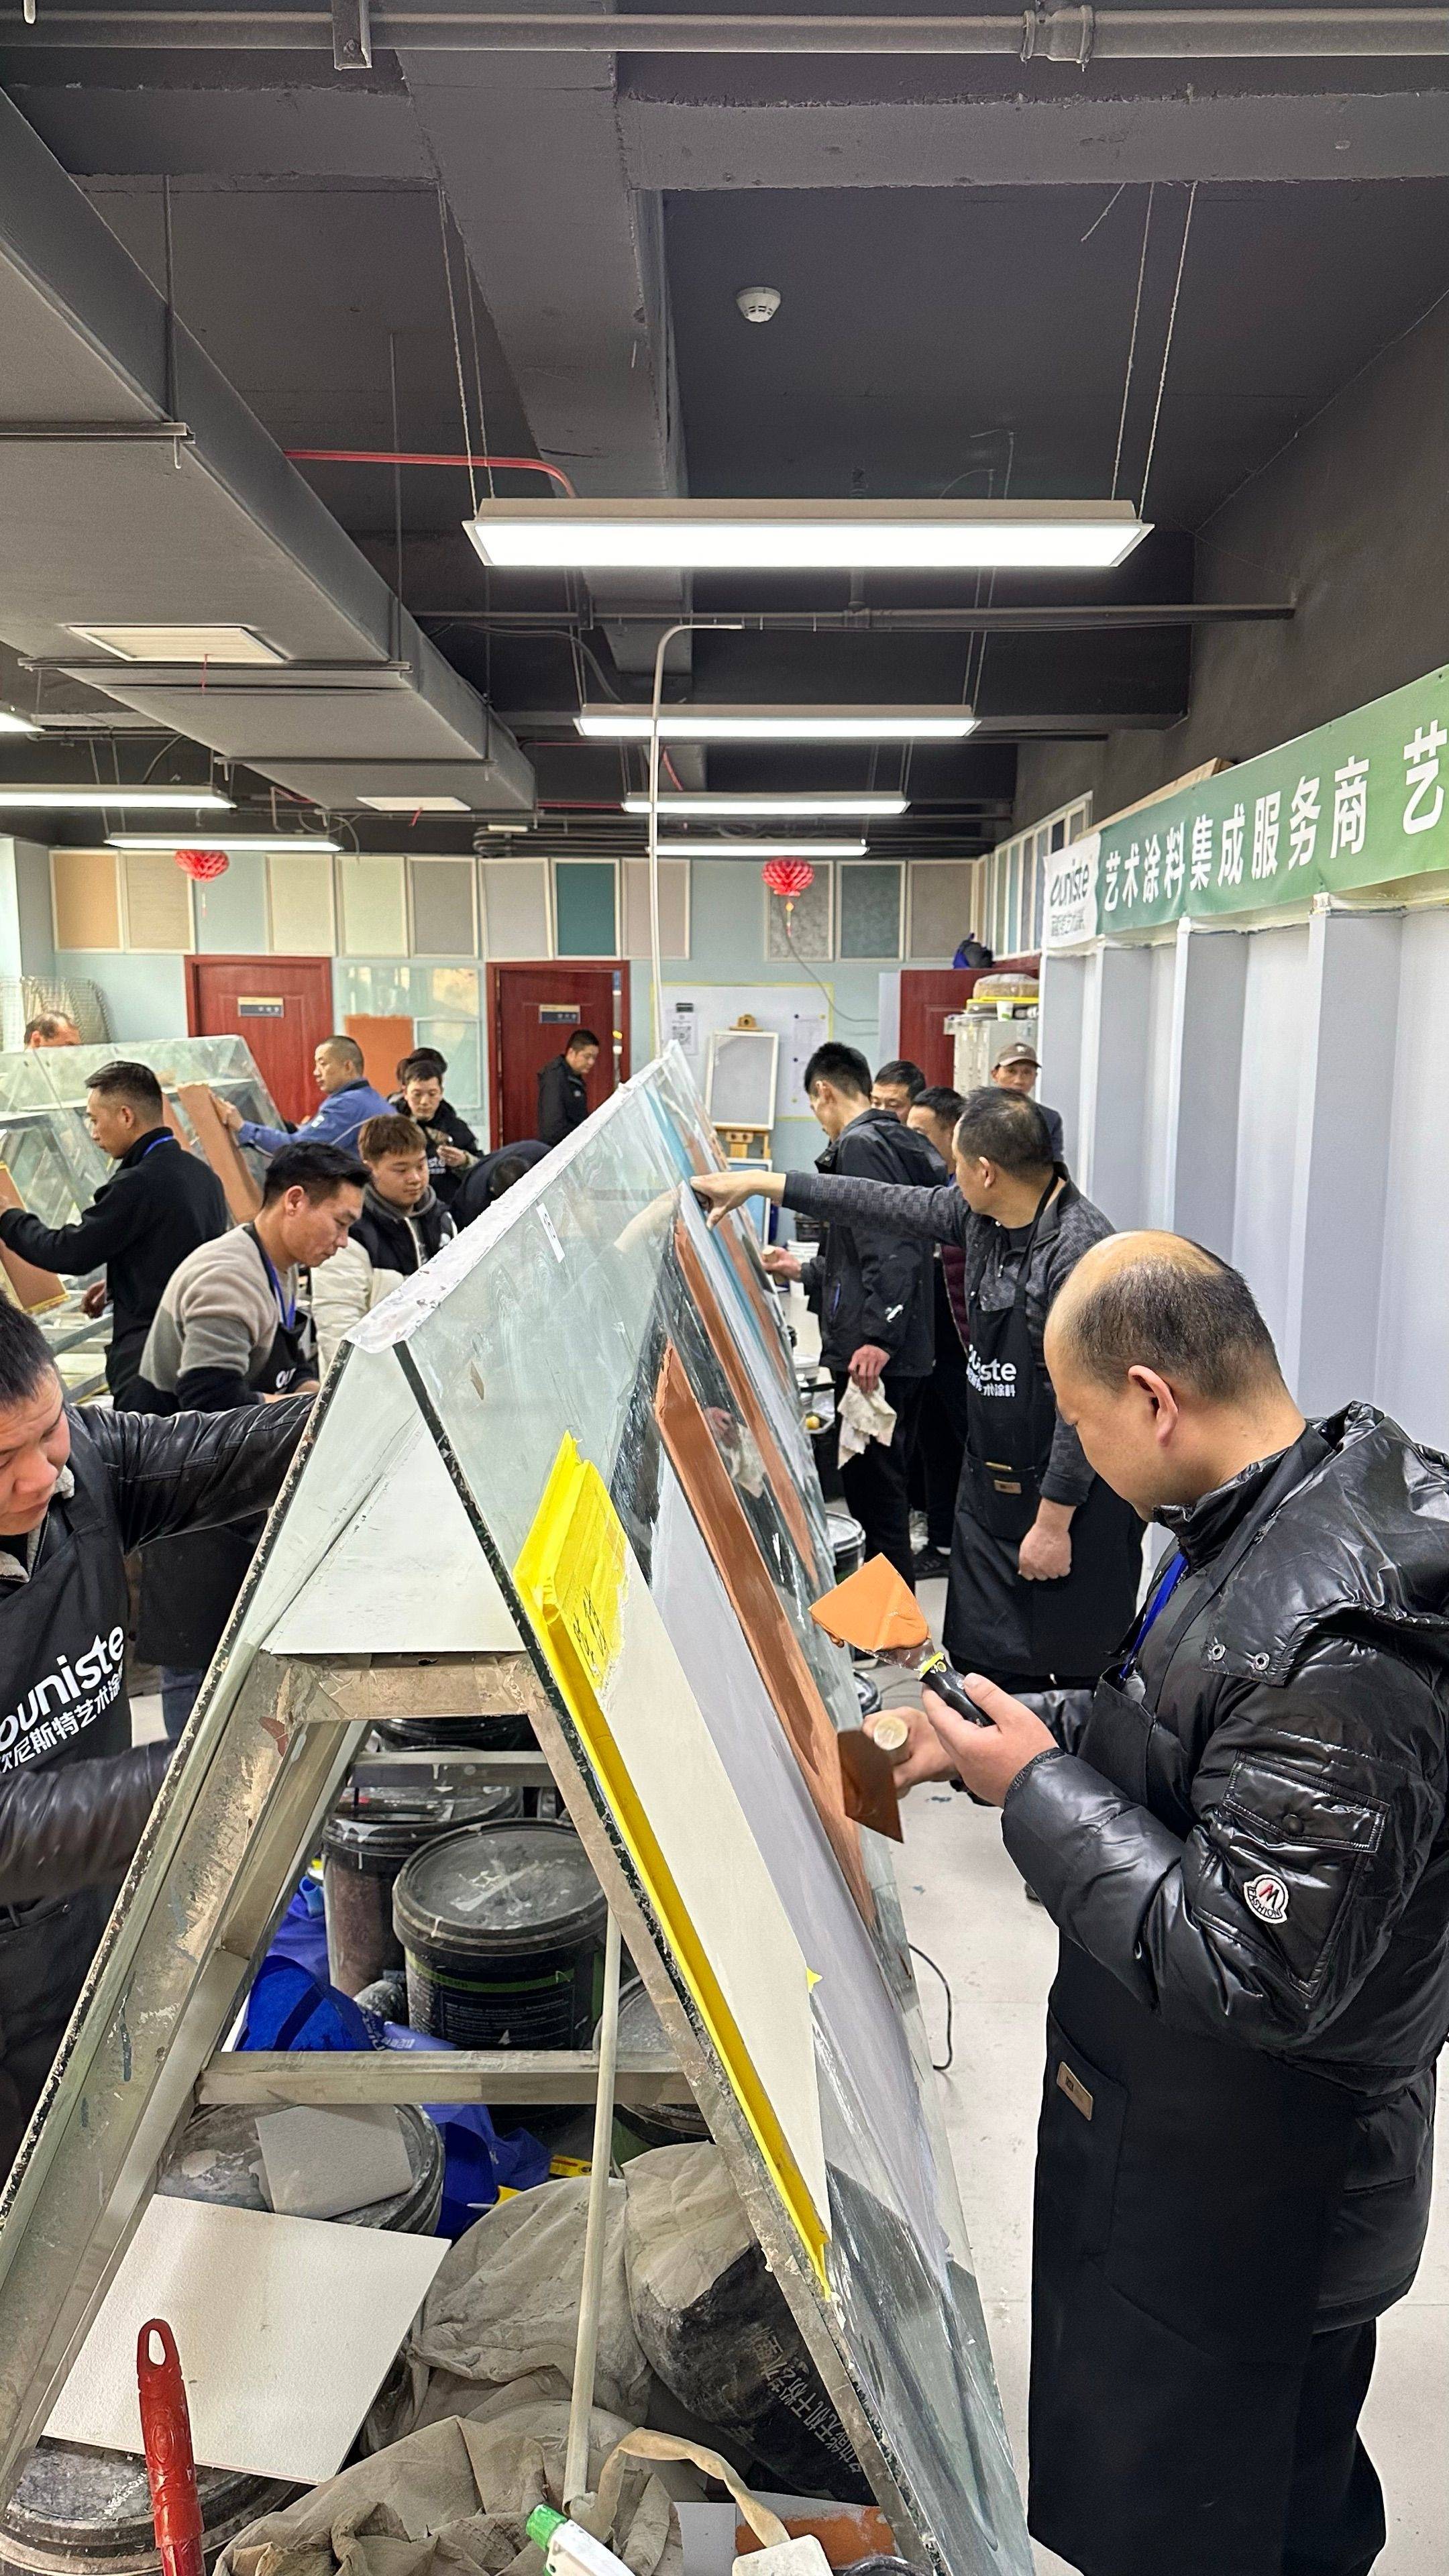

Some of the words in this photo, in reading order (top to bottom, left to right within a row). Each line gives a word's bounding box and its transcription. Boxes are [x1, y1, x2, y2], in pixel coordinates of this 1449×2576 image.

[1104, 755, 1371, 912] 艺术涂料集成服务商
[1402, 718, 1448, 835] 艺
[0, 1659, 124, 1774] 尼斯特艺术涂
[1248, 1886, 1281, 1917] FASHION
